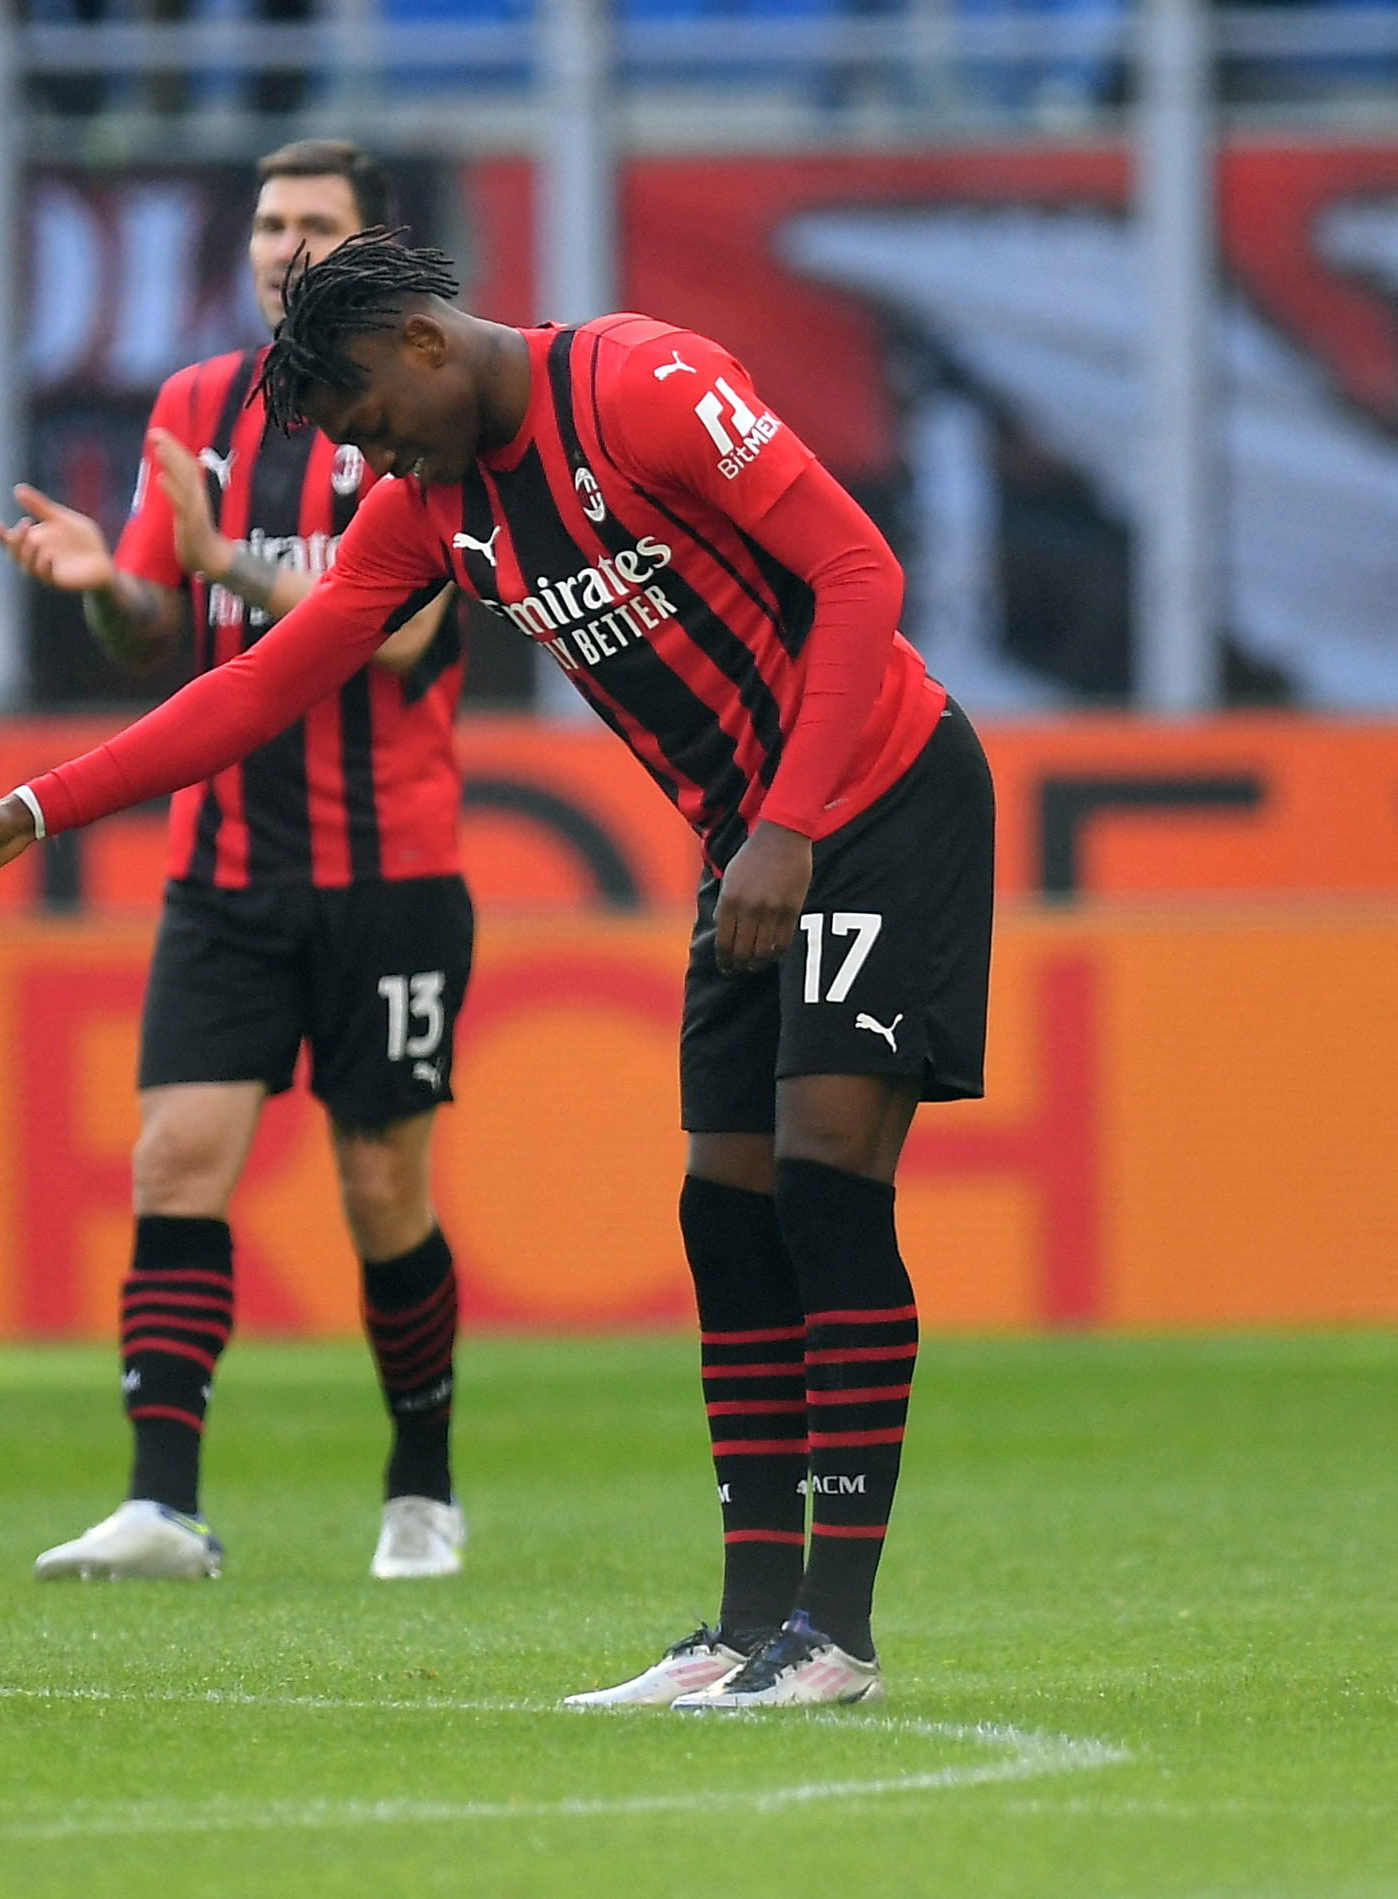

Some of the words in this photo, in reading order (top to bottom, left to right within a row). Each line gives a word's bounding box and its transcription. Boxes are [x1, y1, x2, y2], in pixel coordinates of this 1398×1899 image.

[716, 410, 782, 480] BitMEX
[571, 584, 678, 666] BETTER
[799, 911, 883, 1004] 17
[377, 969, 446, 1061] 13
[812, 1474, 866, 1494] ACM
